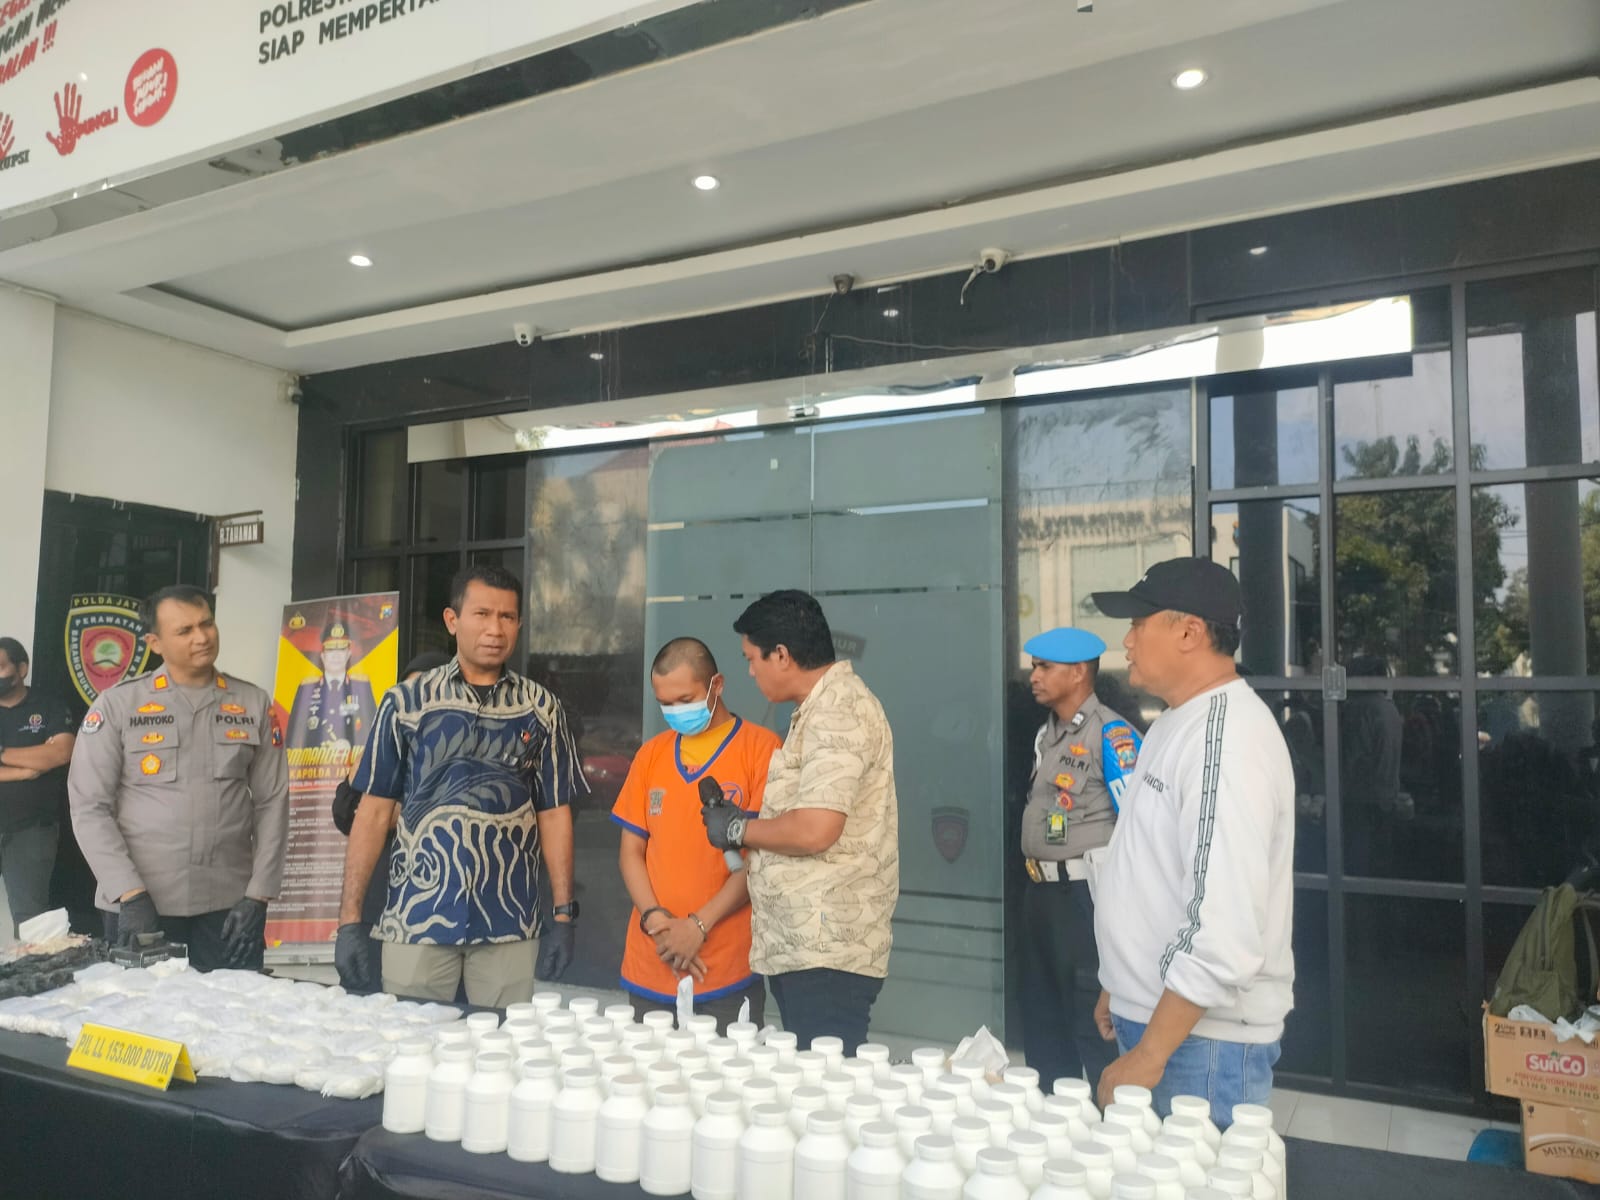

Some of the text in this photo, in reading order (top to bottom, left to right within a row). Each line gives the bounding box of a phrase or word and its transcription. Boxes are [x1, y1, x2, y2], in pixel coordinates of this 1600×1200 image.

[258, 30, 305, 65] SIAP
[73, 596, 139, 610] POLDA JAT
[74, 615, 143, 633] PERAWATAN
[129, 713, 176, 728] HARYOKO
[215, 713, 255, 725] POLRI
[1059, 754, 1090, 773] POLRI
[77, 1034, 93, 1055] PIL
[140, 1049, 172, 1075] BUTIR
[1528, 1054, 1584, 1075] SunCo
